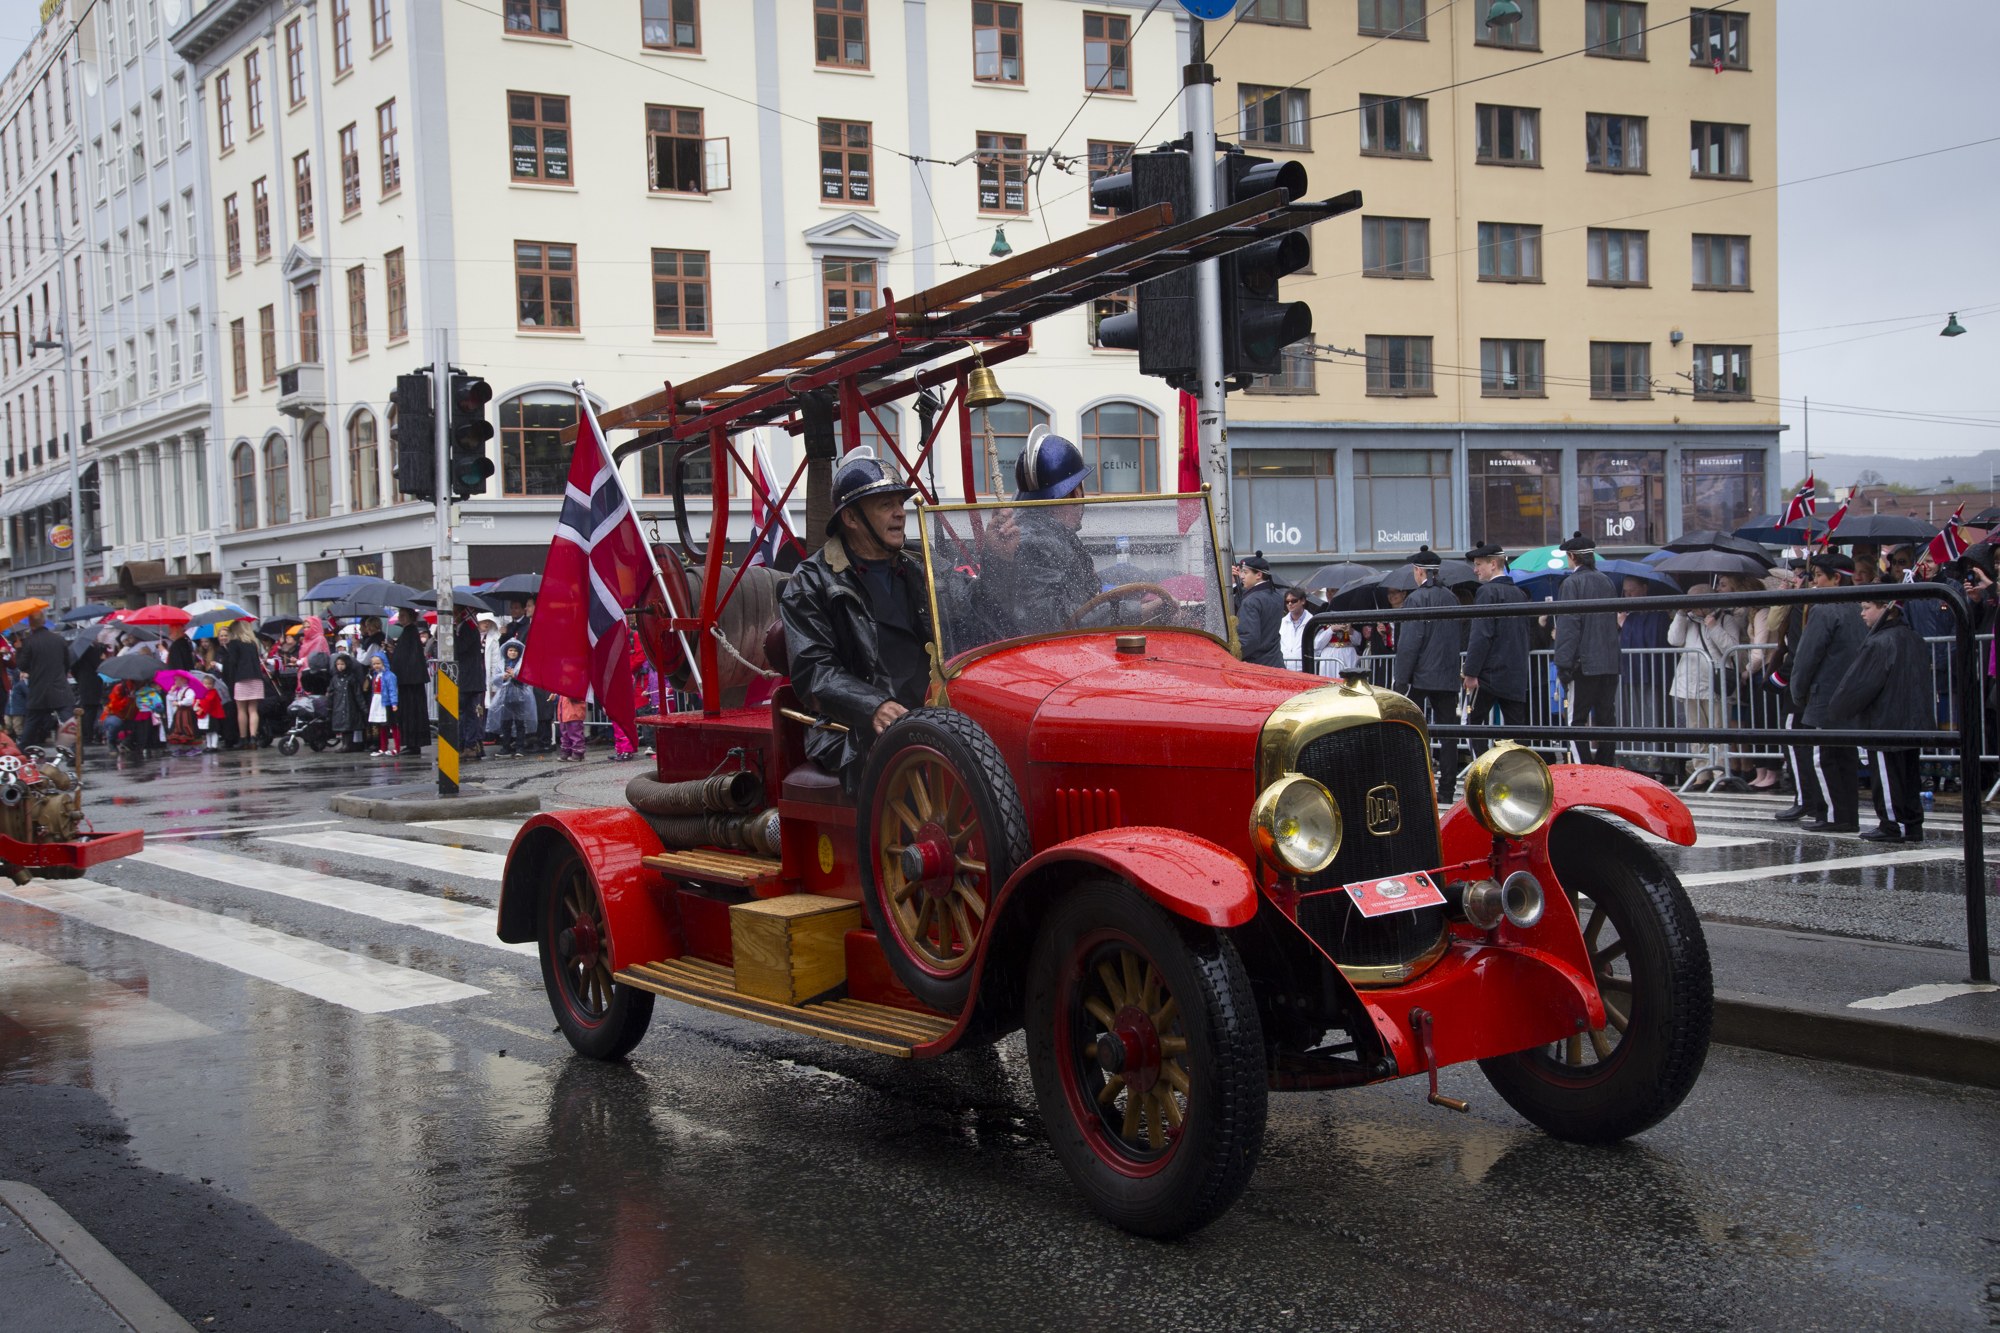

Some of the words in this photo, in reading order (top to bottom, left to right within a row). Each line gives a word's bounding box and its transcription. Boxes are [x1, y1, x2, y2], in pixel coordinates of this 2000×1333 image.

[1265, 522, 1302, 545] lido
[1377, 529, 1430, 543] Restaurant
[1606, 515, 1636, 537] lido
